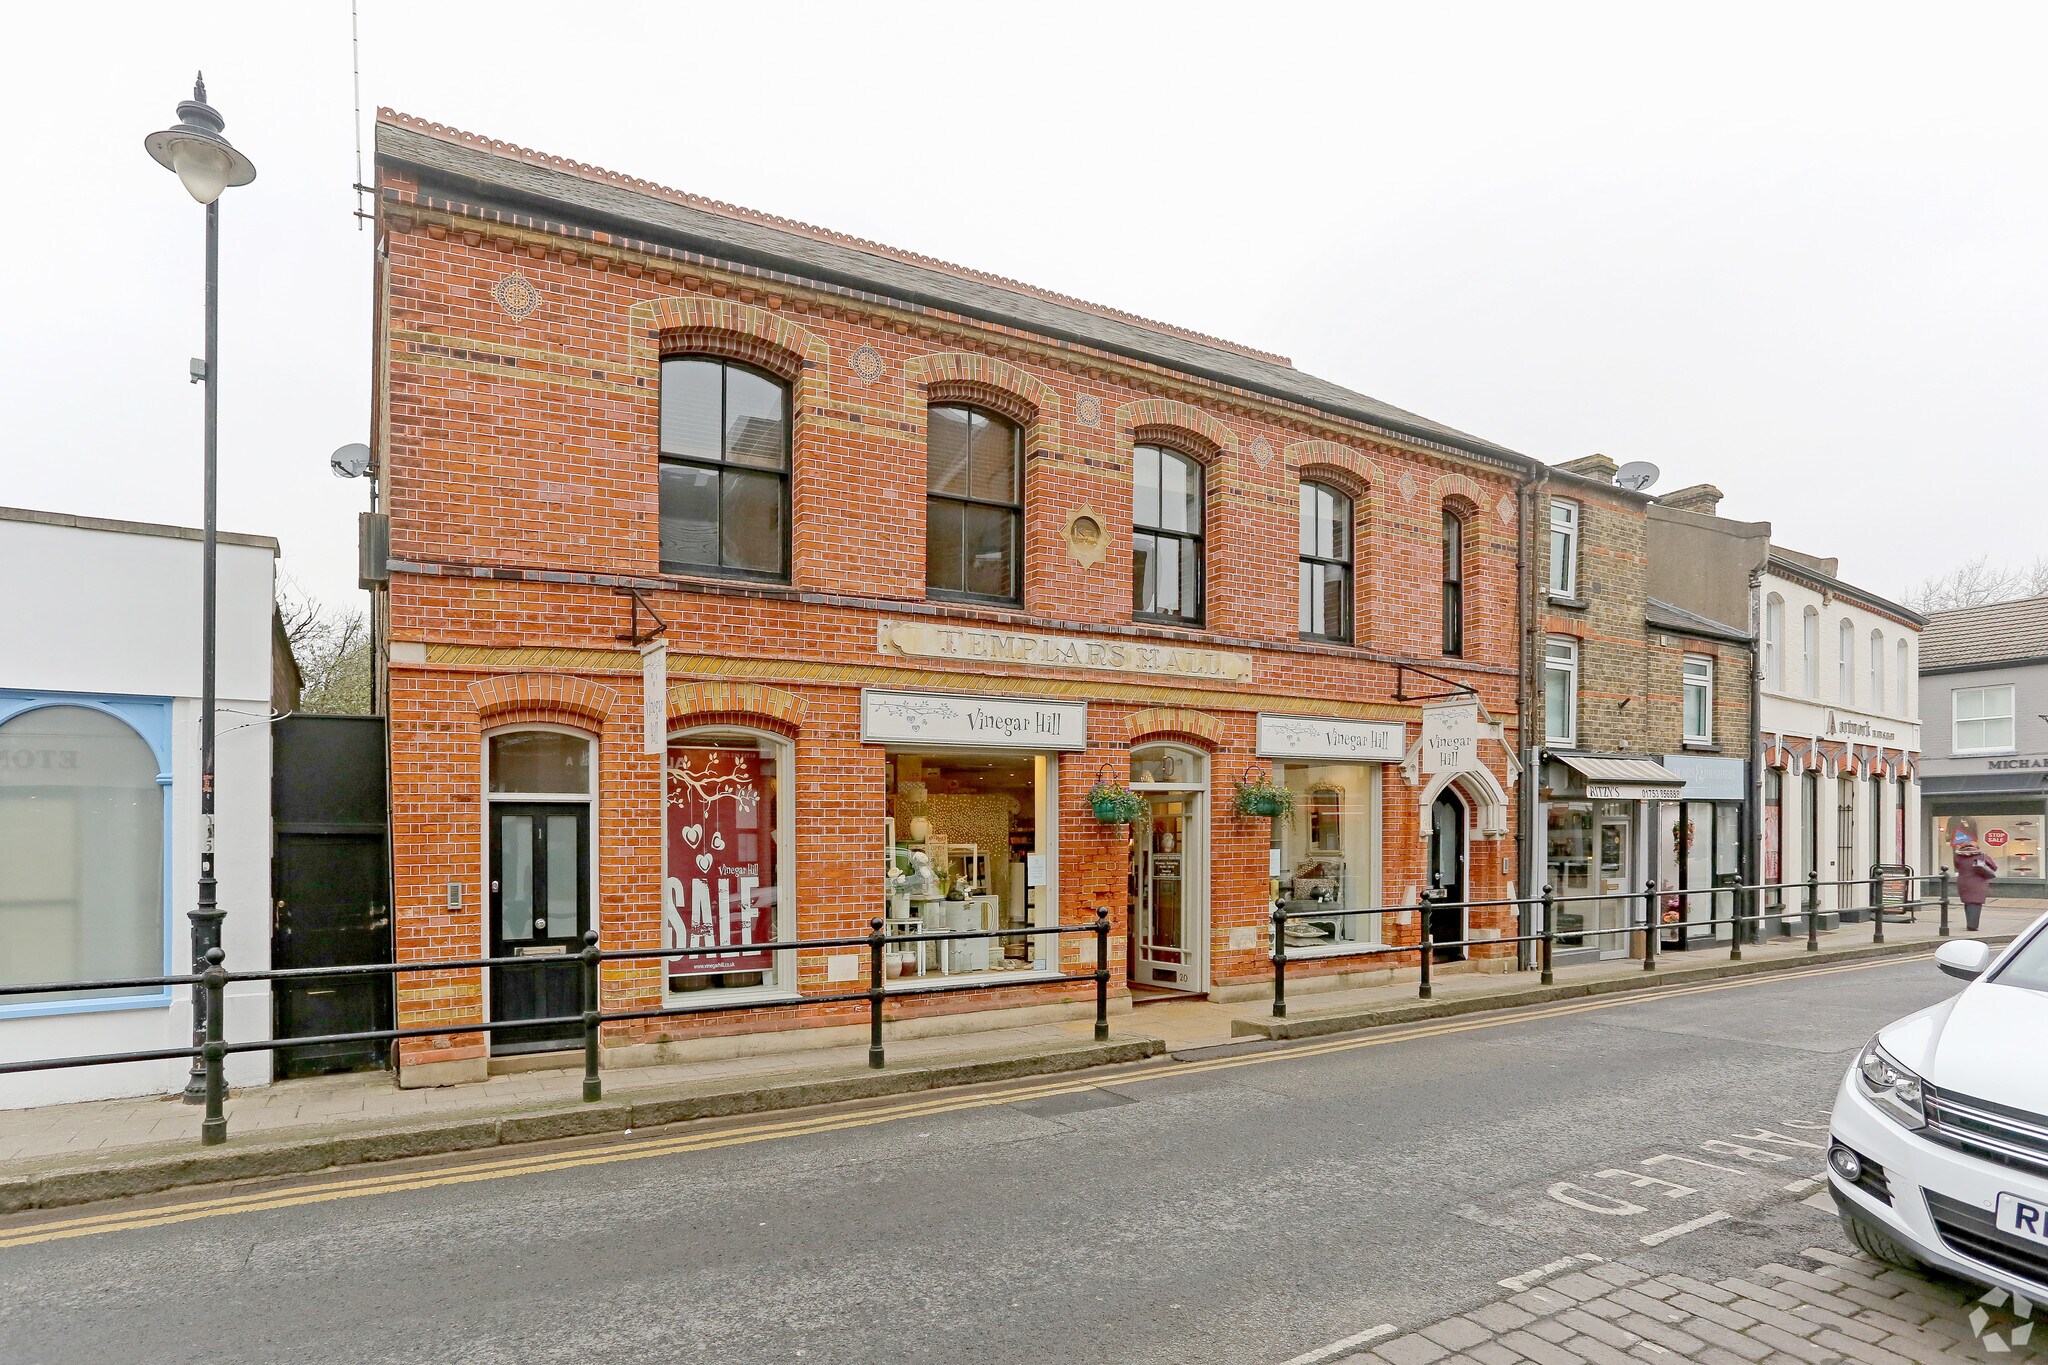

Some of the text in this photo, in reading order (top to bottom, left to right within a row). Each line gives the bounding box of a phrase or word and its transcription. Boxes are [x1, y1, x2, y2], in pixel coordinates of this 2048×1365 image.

[967, 706, 1061, 737] Vinegar Hill
[1325, 727, 1389, 751] Vinegar Hill
[1429, 734, 1472, 751] Vinegar
[1440, 751, 1458, 767] Hill
[1590, 786, 1620, 798] RITZY'S
[1642, 789, 1659, 798] 01753
[718, 863, 759, 877] Vinegar Hill
[667, 876, 762, 961] SALE
[1179, 973, 1188, 983] 20
